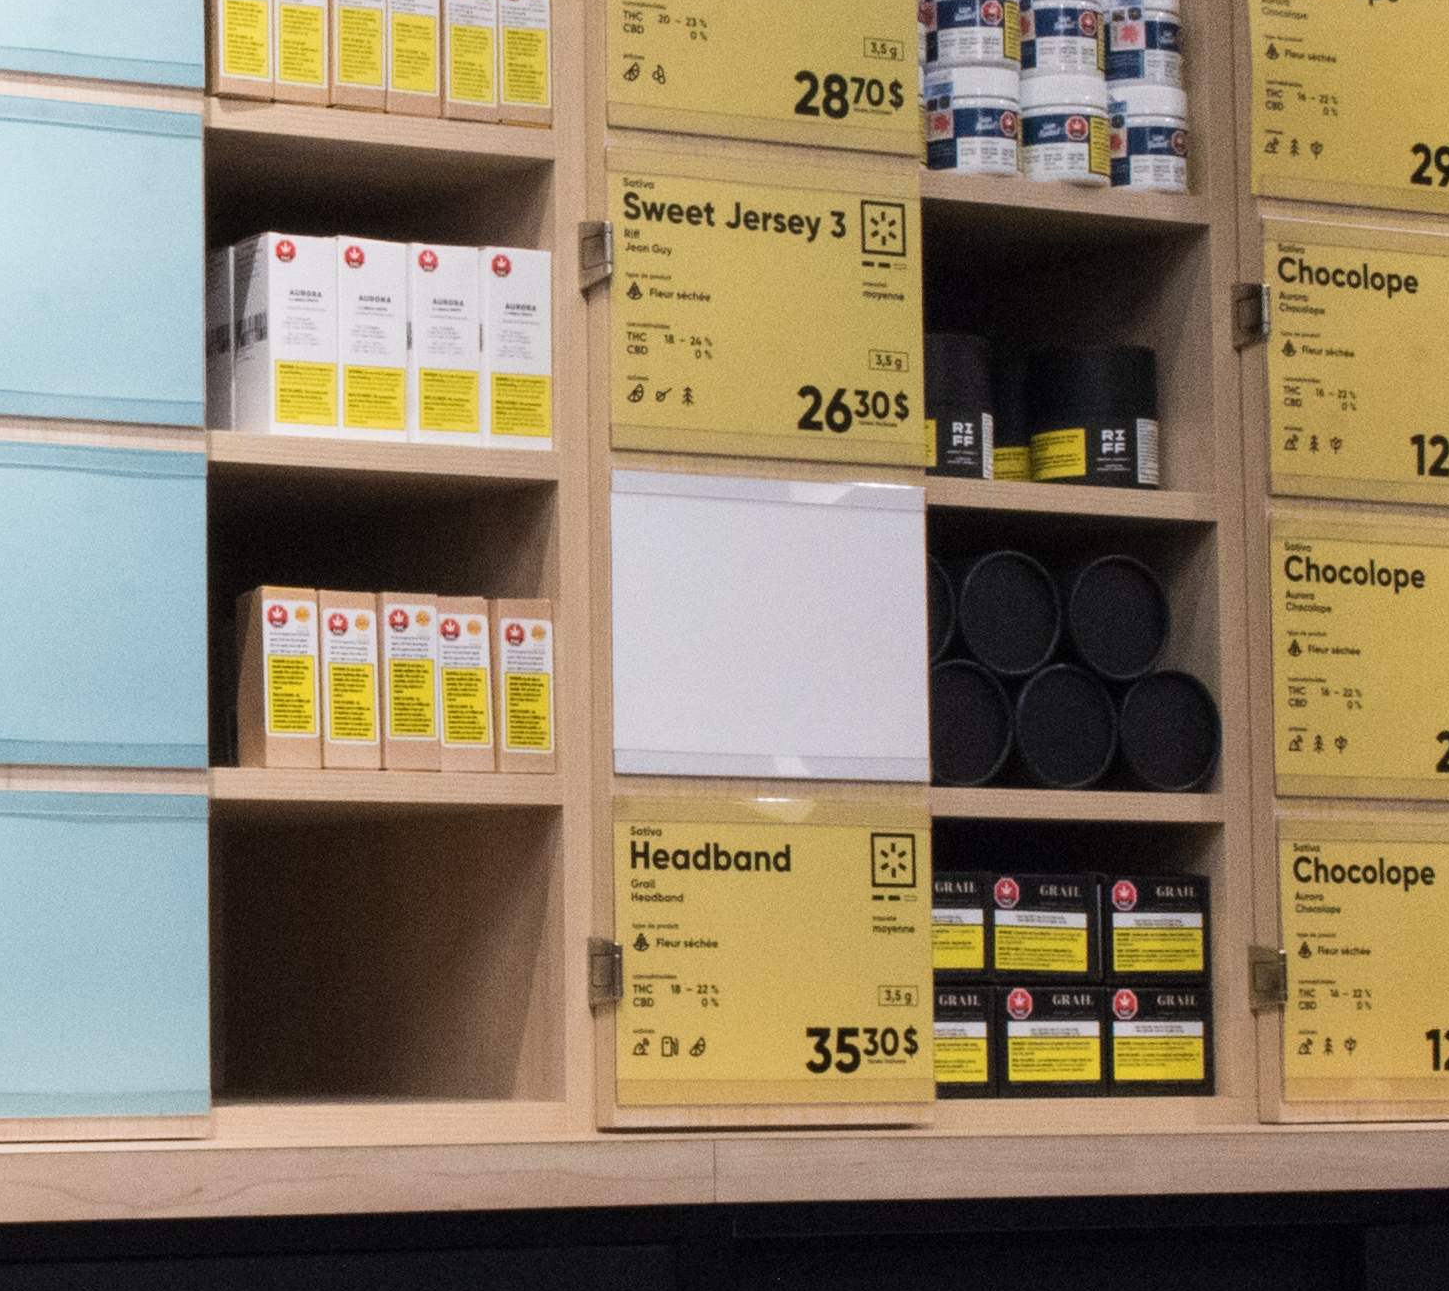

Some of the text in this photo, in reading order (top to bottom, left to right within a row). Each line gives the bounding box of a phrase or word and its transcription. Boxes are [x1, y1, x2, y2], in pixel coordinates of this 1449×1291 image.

[623, 192, 846, 242] Sweet Jersey 3
[625, 242, 672, 256] Jean Guy
[1277, 257, 1419, 298] Chocolope
[1284, 555, 1425, 594] Chocolope
[630, 826, 662, 837] Sativa
[630, 842, 792, 872] Headband
[631, 878, 656, 889] Grail
[1293, 856, 1435, 892] Chocolope
[631, 893, 684, 903] Headband
